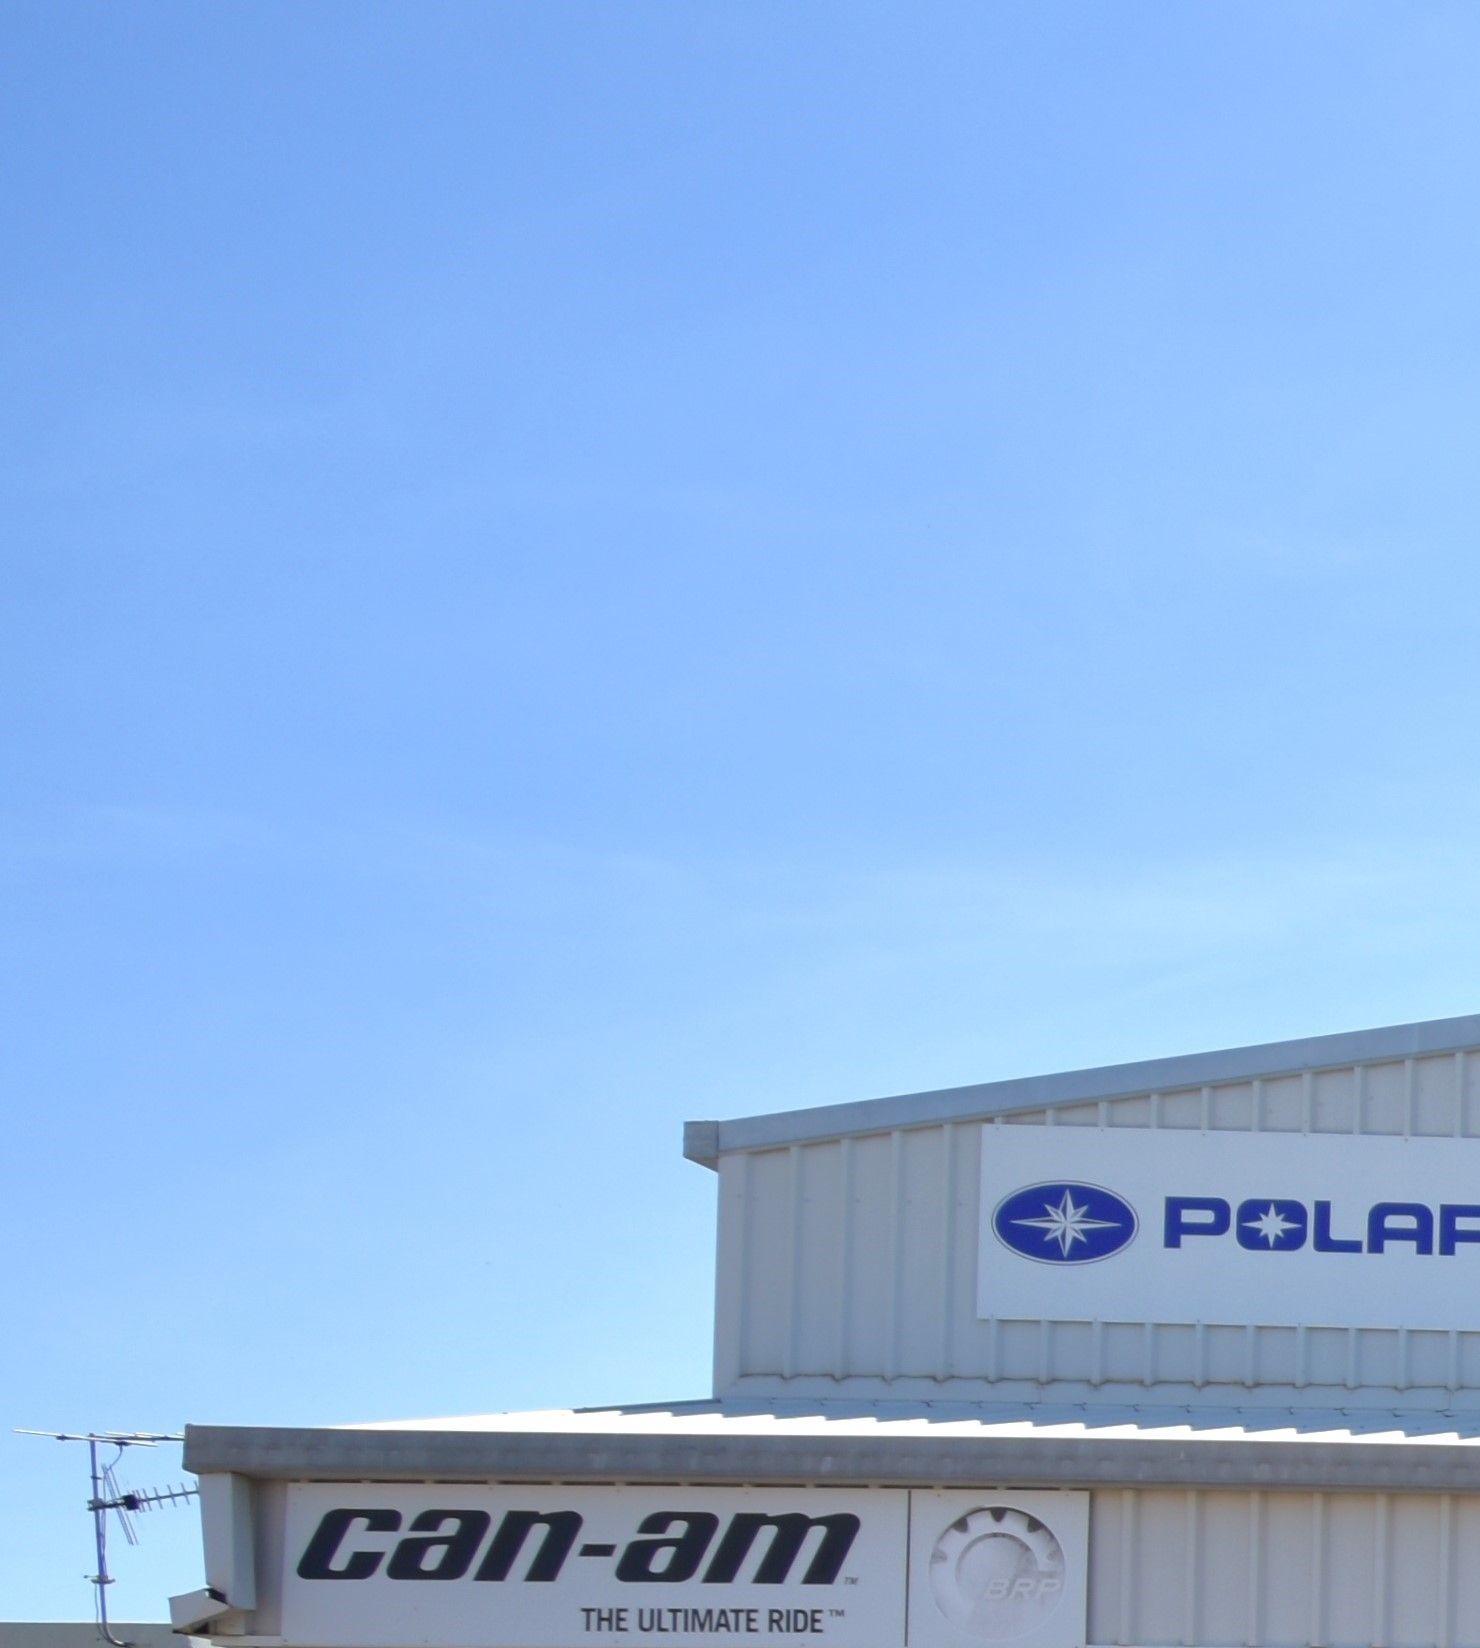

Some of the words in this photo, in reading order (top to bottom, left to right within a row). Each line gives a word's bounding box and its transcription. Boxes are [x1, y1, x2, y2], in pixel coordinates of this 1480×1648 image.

[297, 1509, 860, 1584] can-am
[984, 1579, 1061, 1602] BRP
[581, 1608, 628, 1632] THE
[639, 1609, 758, 1632] ULTIMATE
